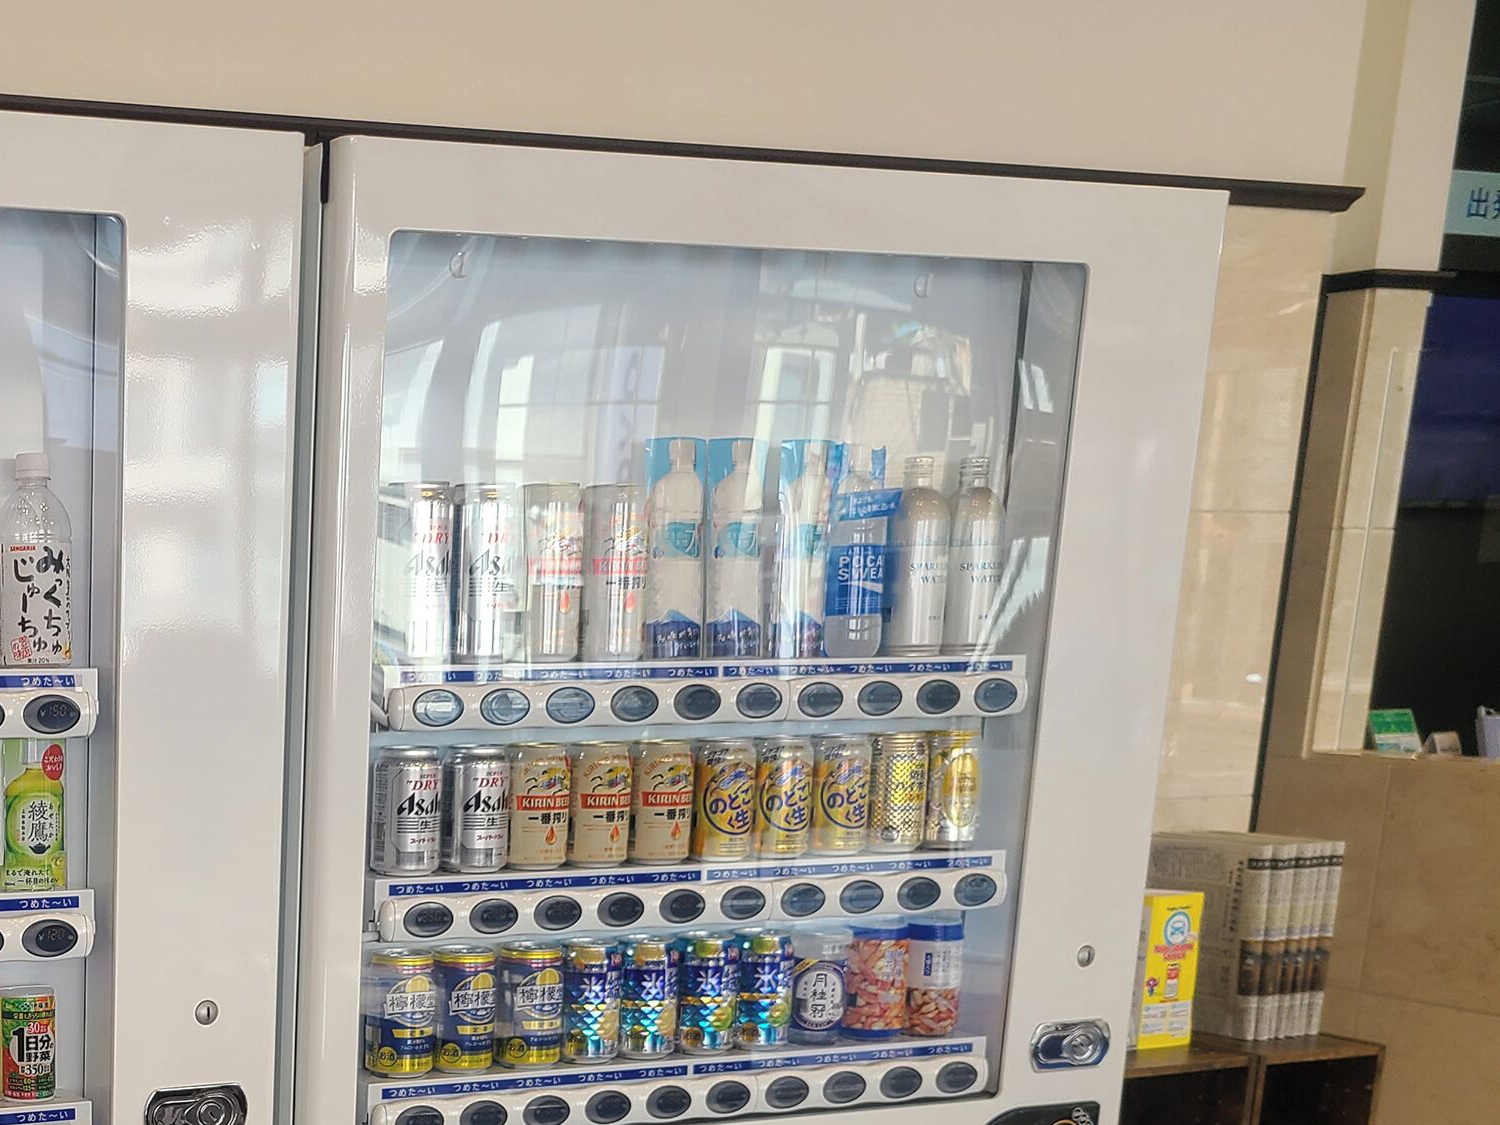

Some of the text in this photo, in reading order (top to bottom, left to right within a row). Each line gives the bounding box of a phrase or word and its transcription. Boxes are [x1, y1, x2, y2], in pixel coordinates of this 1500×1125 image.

[521, 796, 555, 808] KIRIN
[587, 796, 619, 806] KIRIN
[648, 794, 680, 804] KIRIN
[28, 800, 49, 843] 綾鷹
[25, 1052, 51, 1063] 野菜
